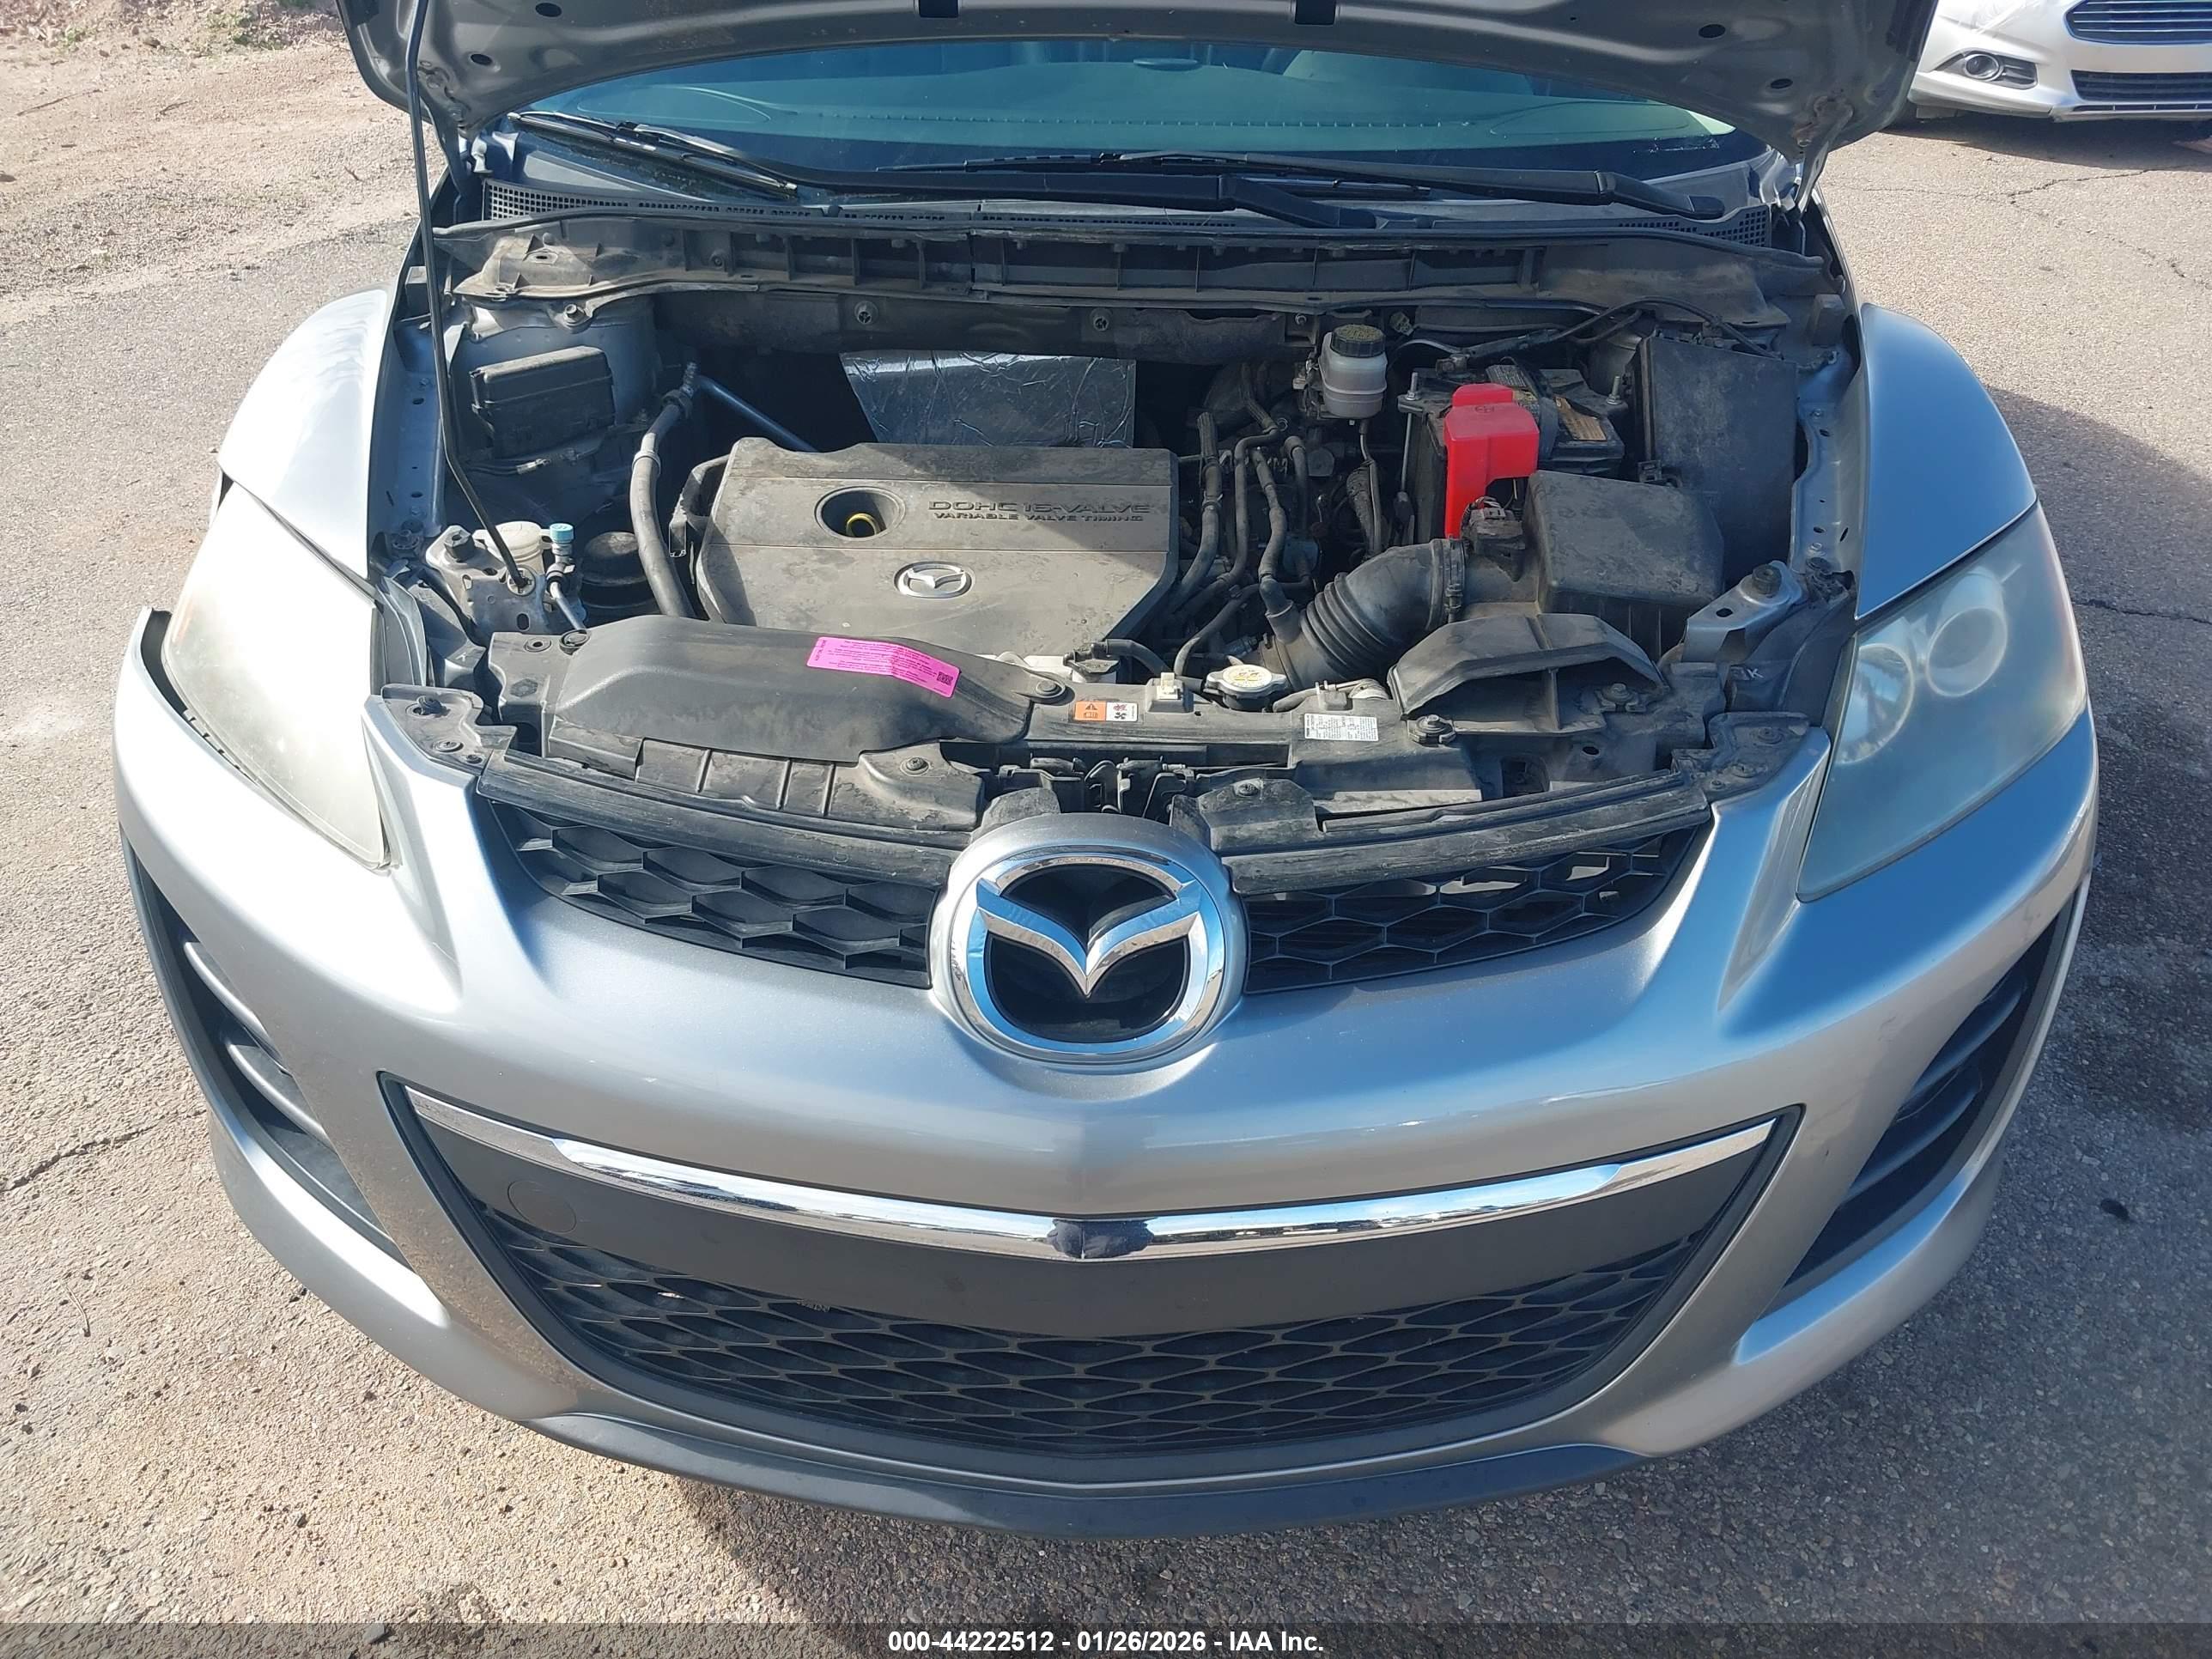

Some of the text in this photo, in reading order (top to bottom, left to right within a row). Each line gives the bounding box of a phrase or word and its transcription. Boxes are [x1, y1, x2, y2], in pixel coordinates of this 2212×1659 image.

[928, 501, 1151, 514] DOHC 16-VALVE
[933, 512, 1019, 520] VARIABLE
[1024, 514, 1077, 522] VALVE
